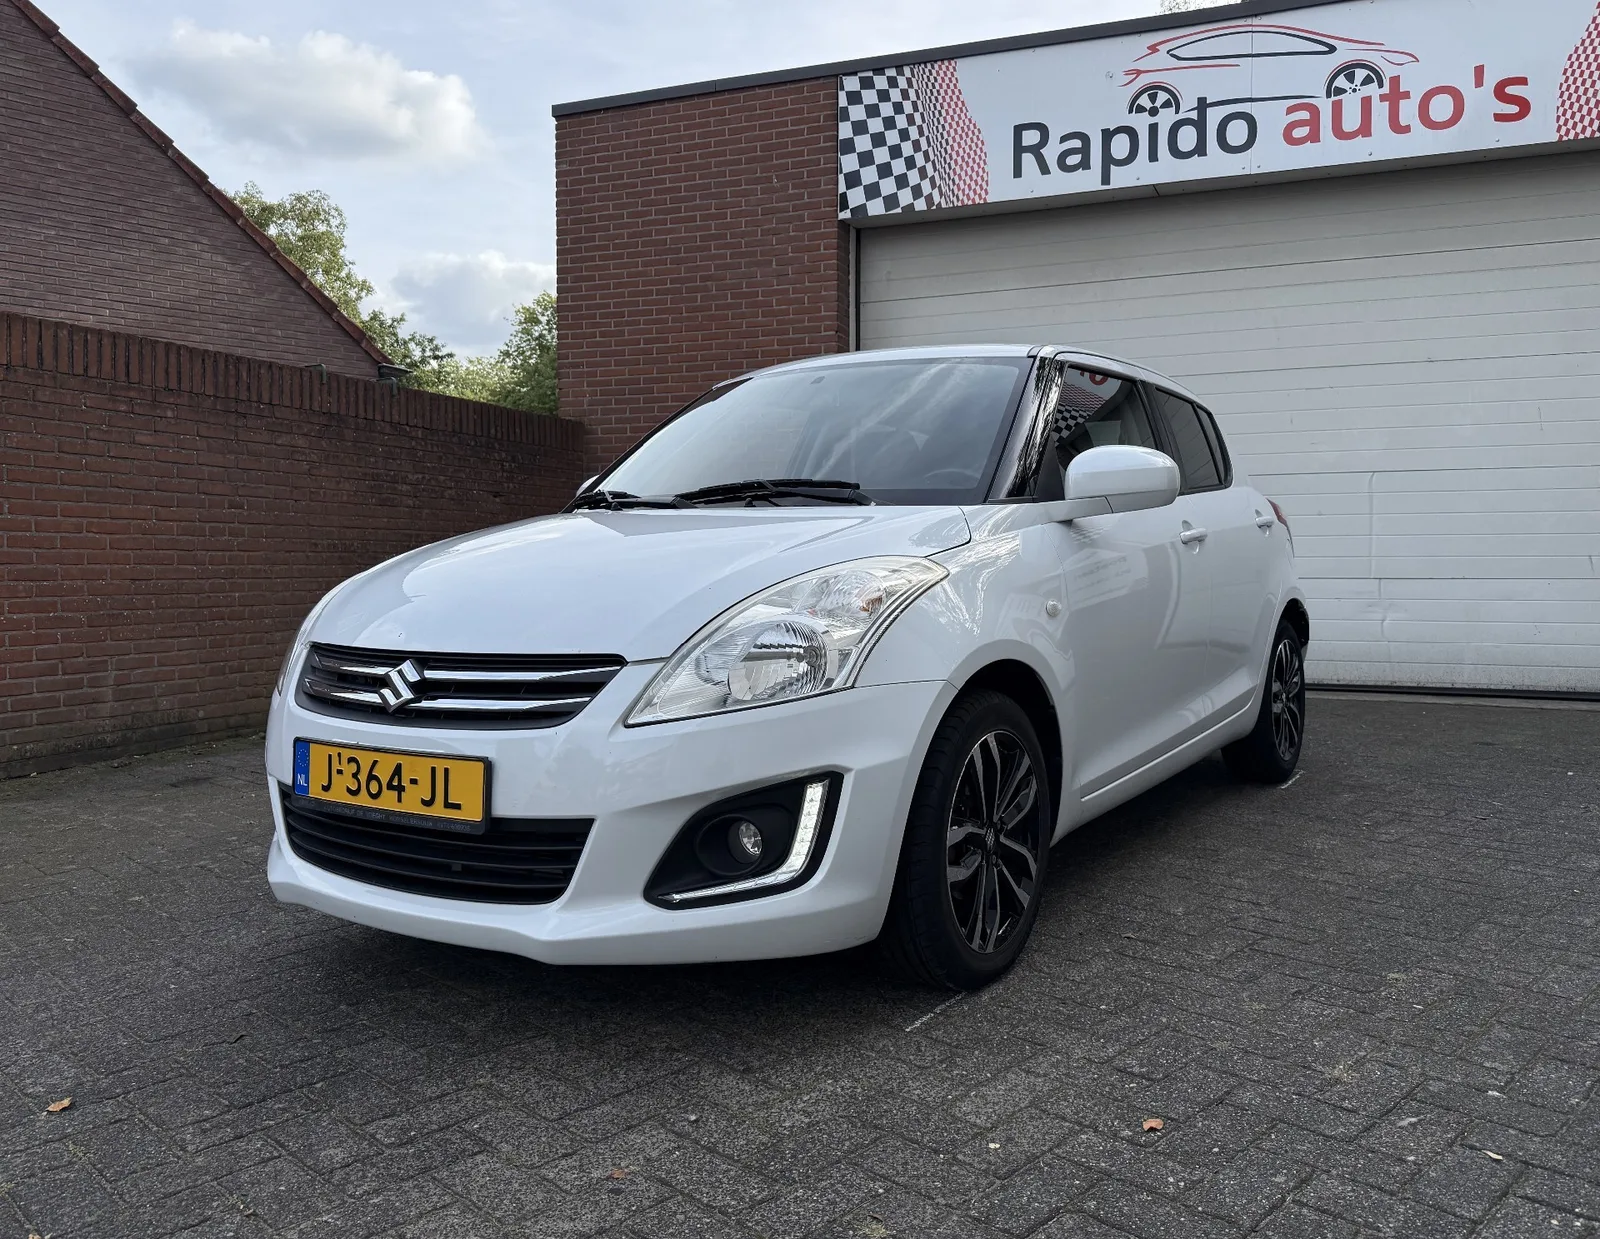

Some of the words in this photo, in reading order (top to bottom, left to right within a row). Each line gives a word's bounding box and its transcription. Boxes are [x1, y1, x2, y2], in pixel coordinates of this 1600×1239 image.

[1012, 96, 1258, 186] Rapido
[1282, 65, 1532, 147] auto's
[297, 773, 308, 787] NL
